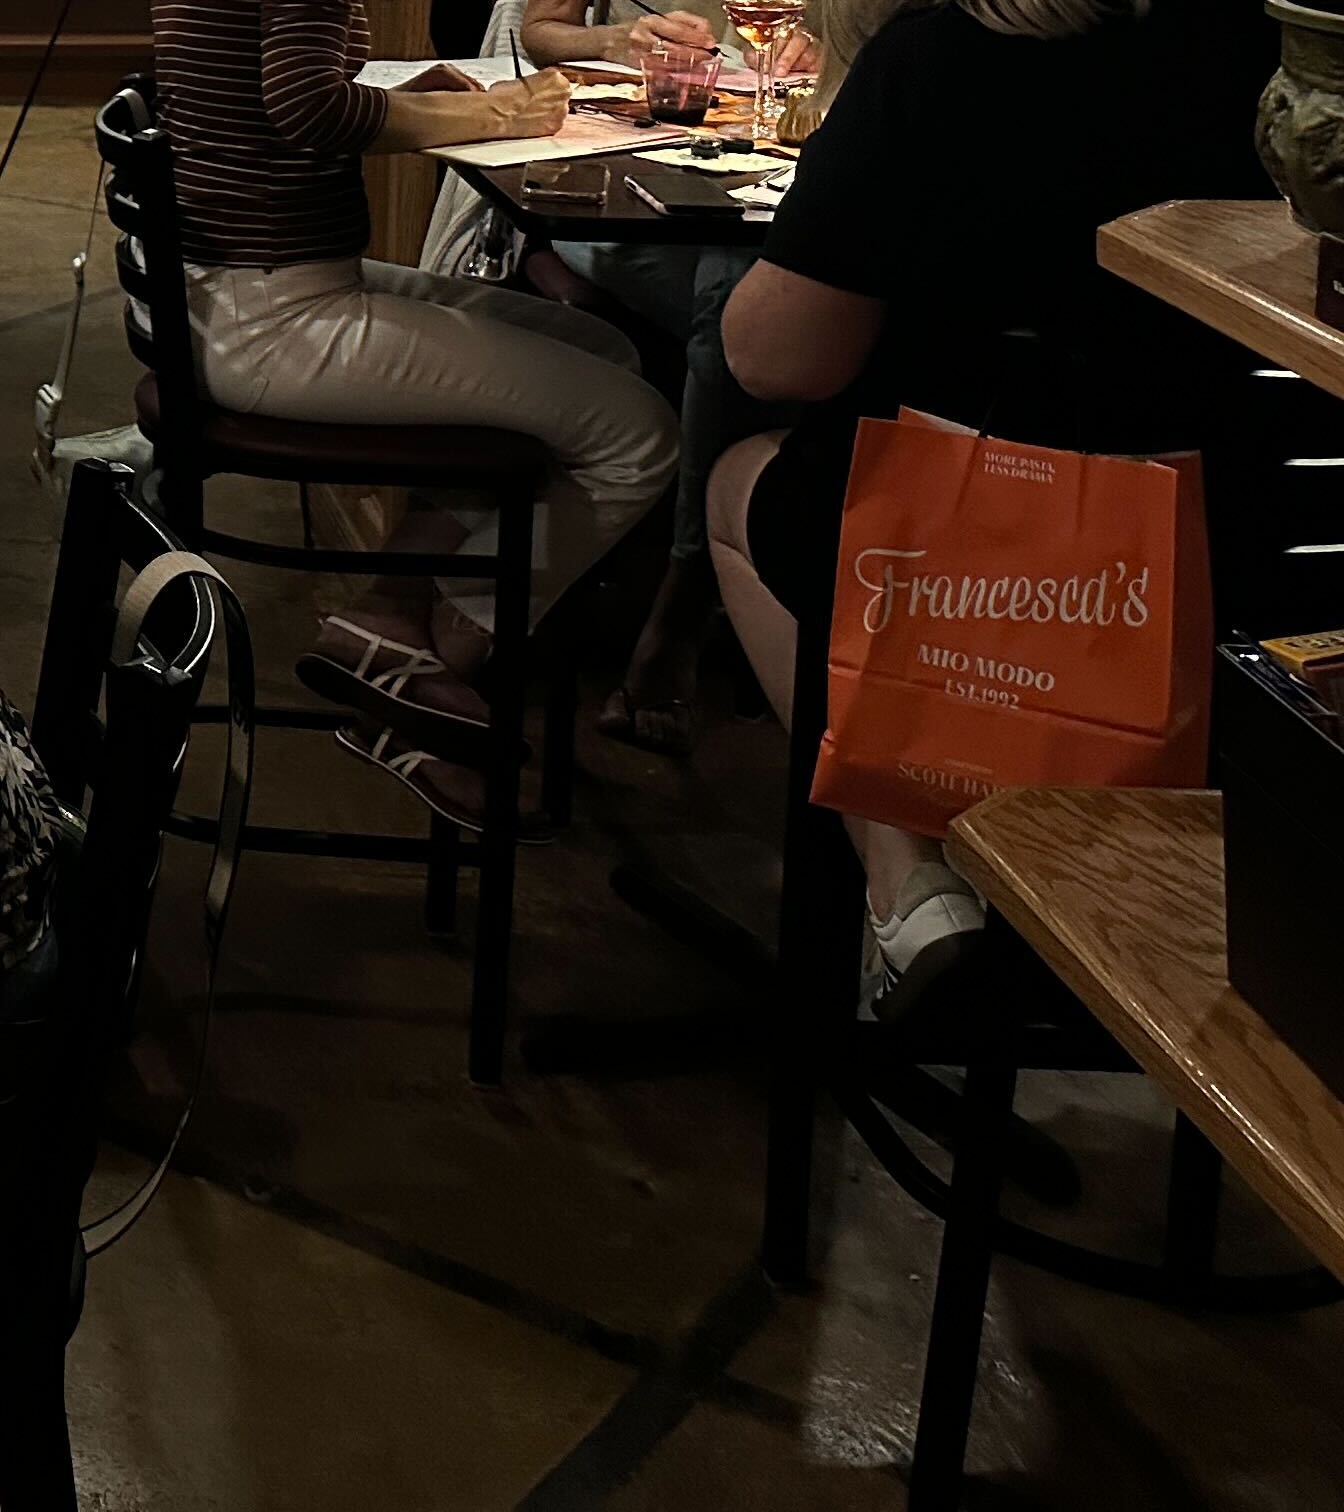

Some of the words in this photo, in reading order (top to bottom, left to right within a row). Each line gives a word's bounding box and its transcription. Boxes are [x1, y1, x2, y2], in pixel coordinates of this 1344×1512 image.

[984, 451, 1017, 466] MORE
[854, 548, 1150, 634] Francesca's
[916, 643, 970, 672] MIO
[975, 656, 1056, 692] MODO
